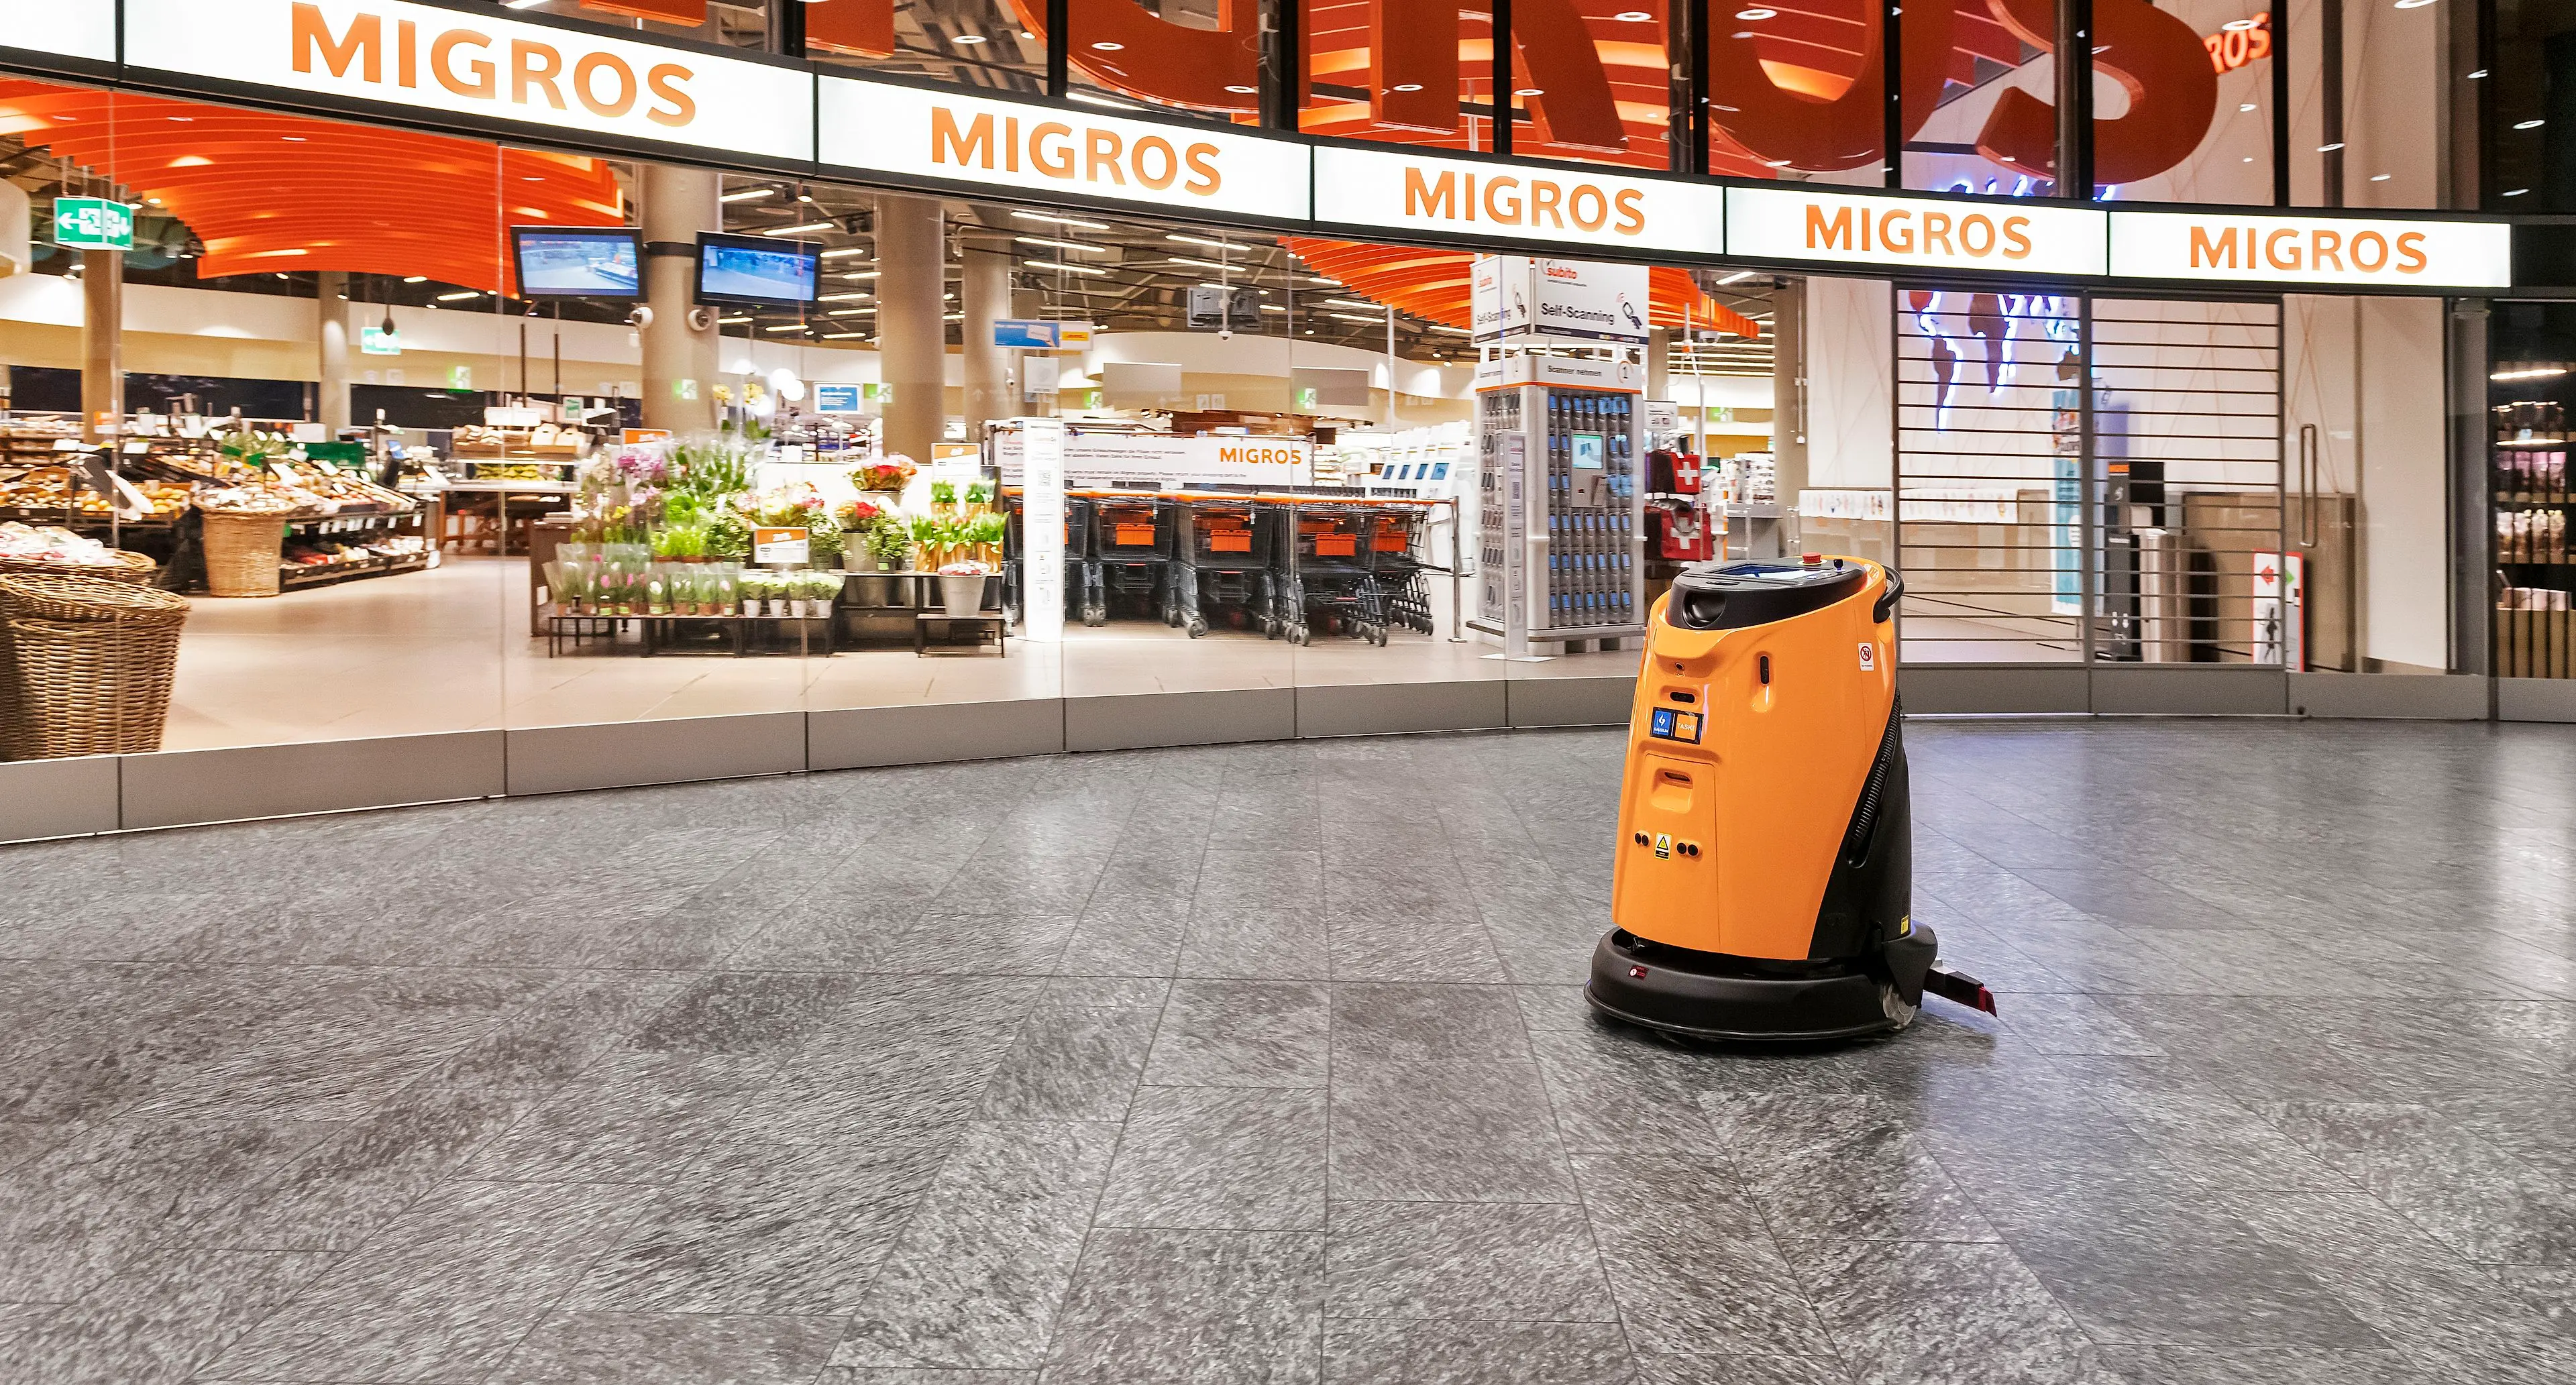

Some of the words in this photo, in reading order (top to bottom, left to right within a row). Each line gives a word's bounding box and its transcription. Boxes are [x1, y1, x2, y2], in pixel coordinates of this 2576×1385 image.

[291, 2, 696, 127] MIGROS
[932, 107, 1222, 196] MIGROS
[1405, 167, 1646, 235] MIGROS
[1805, 204, 2033, 260] MIGROS
[2190, 225, 2428, 274] MIGROS
[1547, 266, 1577, 279] subito
[1540, 302, 1615, 325] Self-Scanning
[1547, 365, 1574, 374] Scanner
[1576, 366, 1603, 377] nehmen
[1219, 447, 1302, 465] MIGROS
[1677, 722, 1695, 731] TASKI
